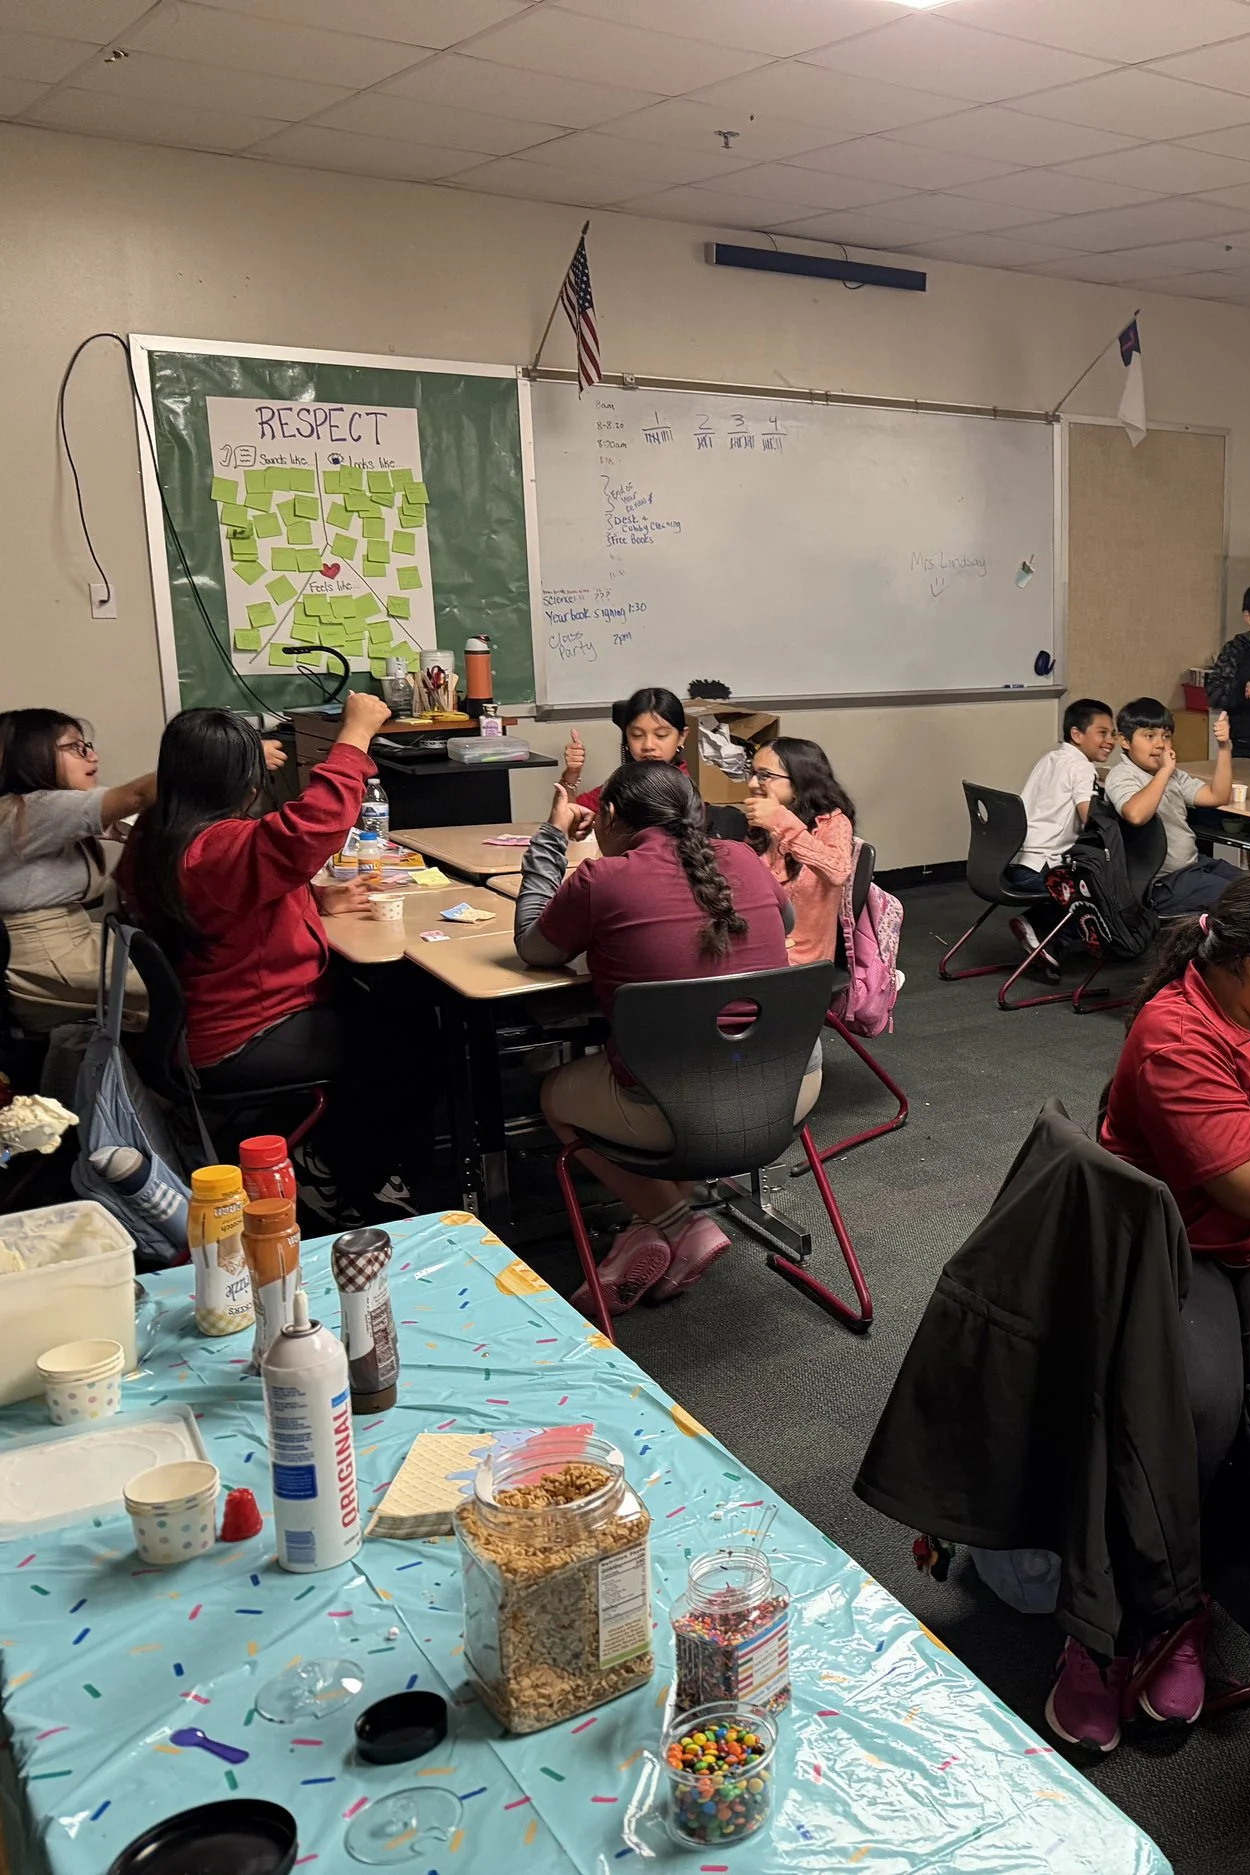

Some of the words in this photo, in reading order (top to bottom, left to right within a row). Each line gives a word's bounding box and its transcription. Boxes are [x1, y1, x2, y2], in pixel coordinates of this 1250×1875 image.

[255, 406, 388, 446] RESPECT
[696, 413, 712, 430] 2
[731, 413, 745, 427] 3
[769, 415, 778, 431] 4
[259, 453, 287, 465] Sounds
[628, 602, 648, 613] 1:30
[548, 631, 584, 649] Class
[332, 1401, 358, 1529] ORIGINAL
